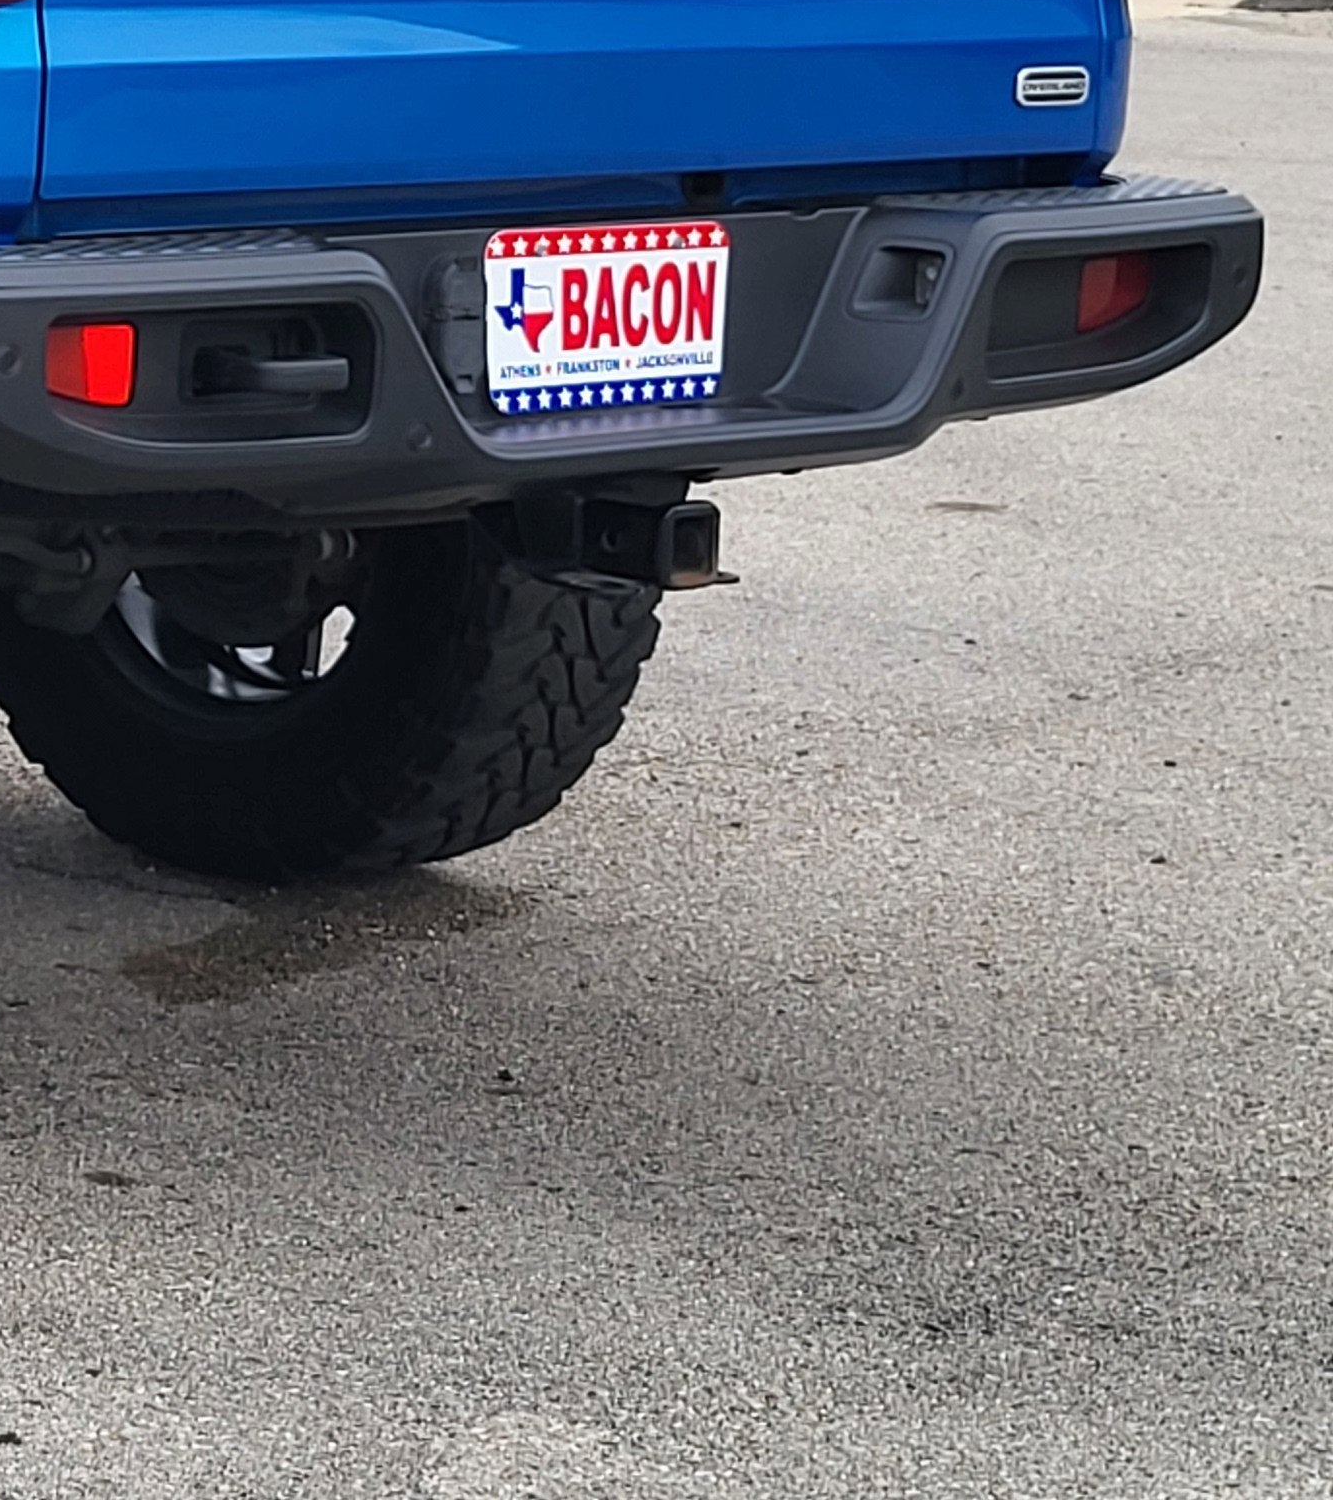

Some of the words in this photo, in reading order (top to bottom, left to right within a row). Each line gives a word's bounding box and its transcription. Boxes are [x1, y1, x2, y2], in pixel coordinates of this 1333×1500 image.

[562, 260, 717, 350] BACON
[499, 363, 541, 379] ATHENS
[556, 358, 621, 376] FRANKSTON
[635, 350, 714, 369] JACKSONVILLE
